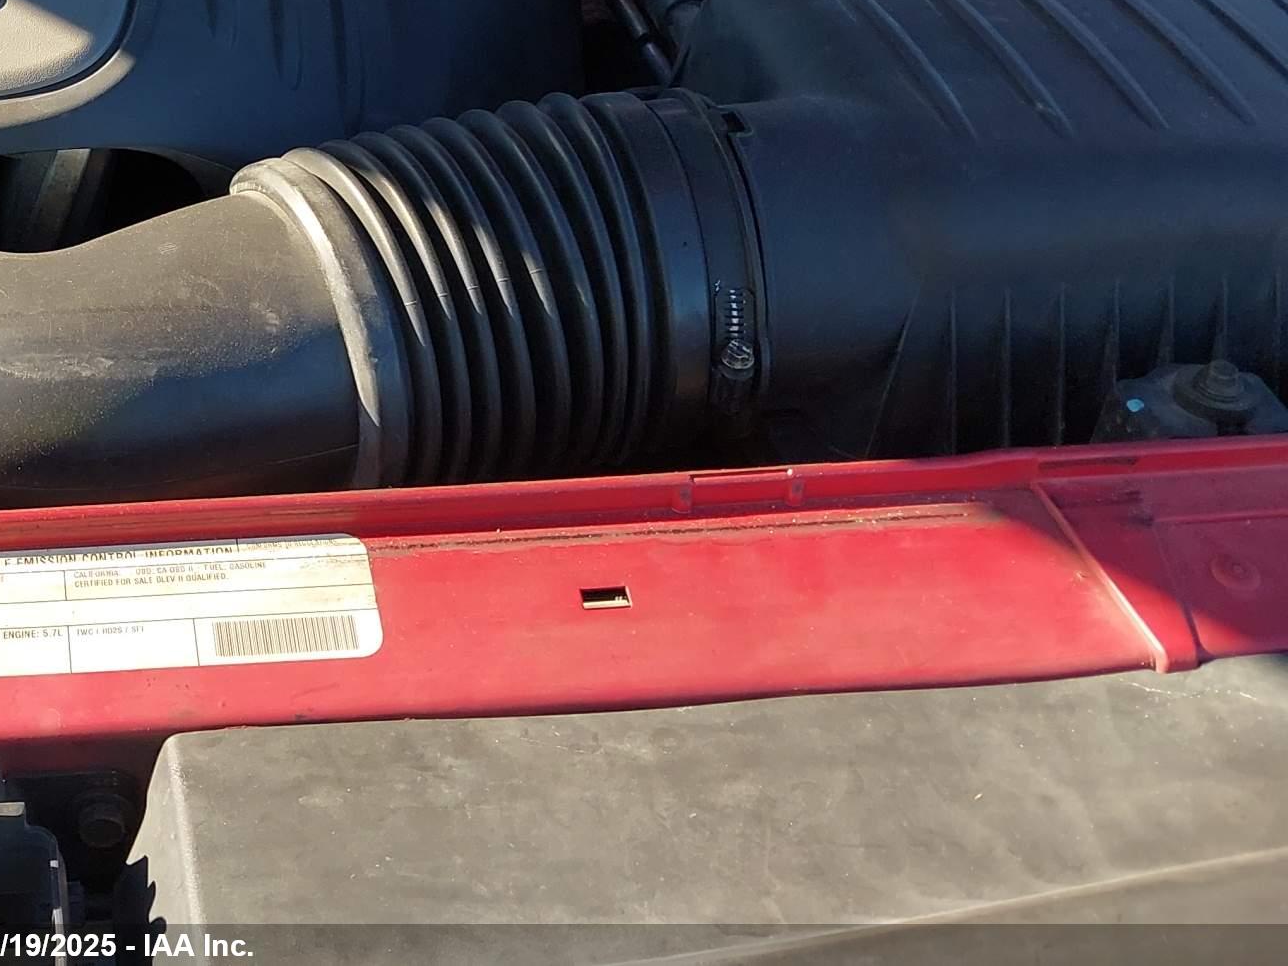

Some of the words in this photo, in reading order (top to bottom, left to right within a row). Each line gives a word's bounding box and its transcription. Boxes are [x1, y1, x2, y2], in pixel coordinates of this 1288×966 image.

[74, 577, 113, 588] CERTIFIED
[116, 577, 131, 586] FOR
[134, 576, 153, 585] SALE
[3, 630, 40, 640] ENGINE:
[42, 629, 64, 638] 5.7L
